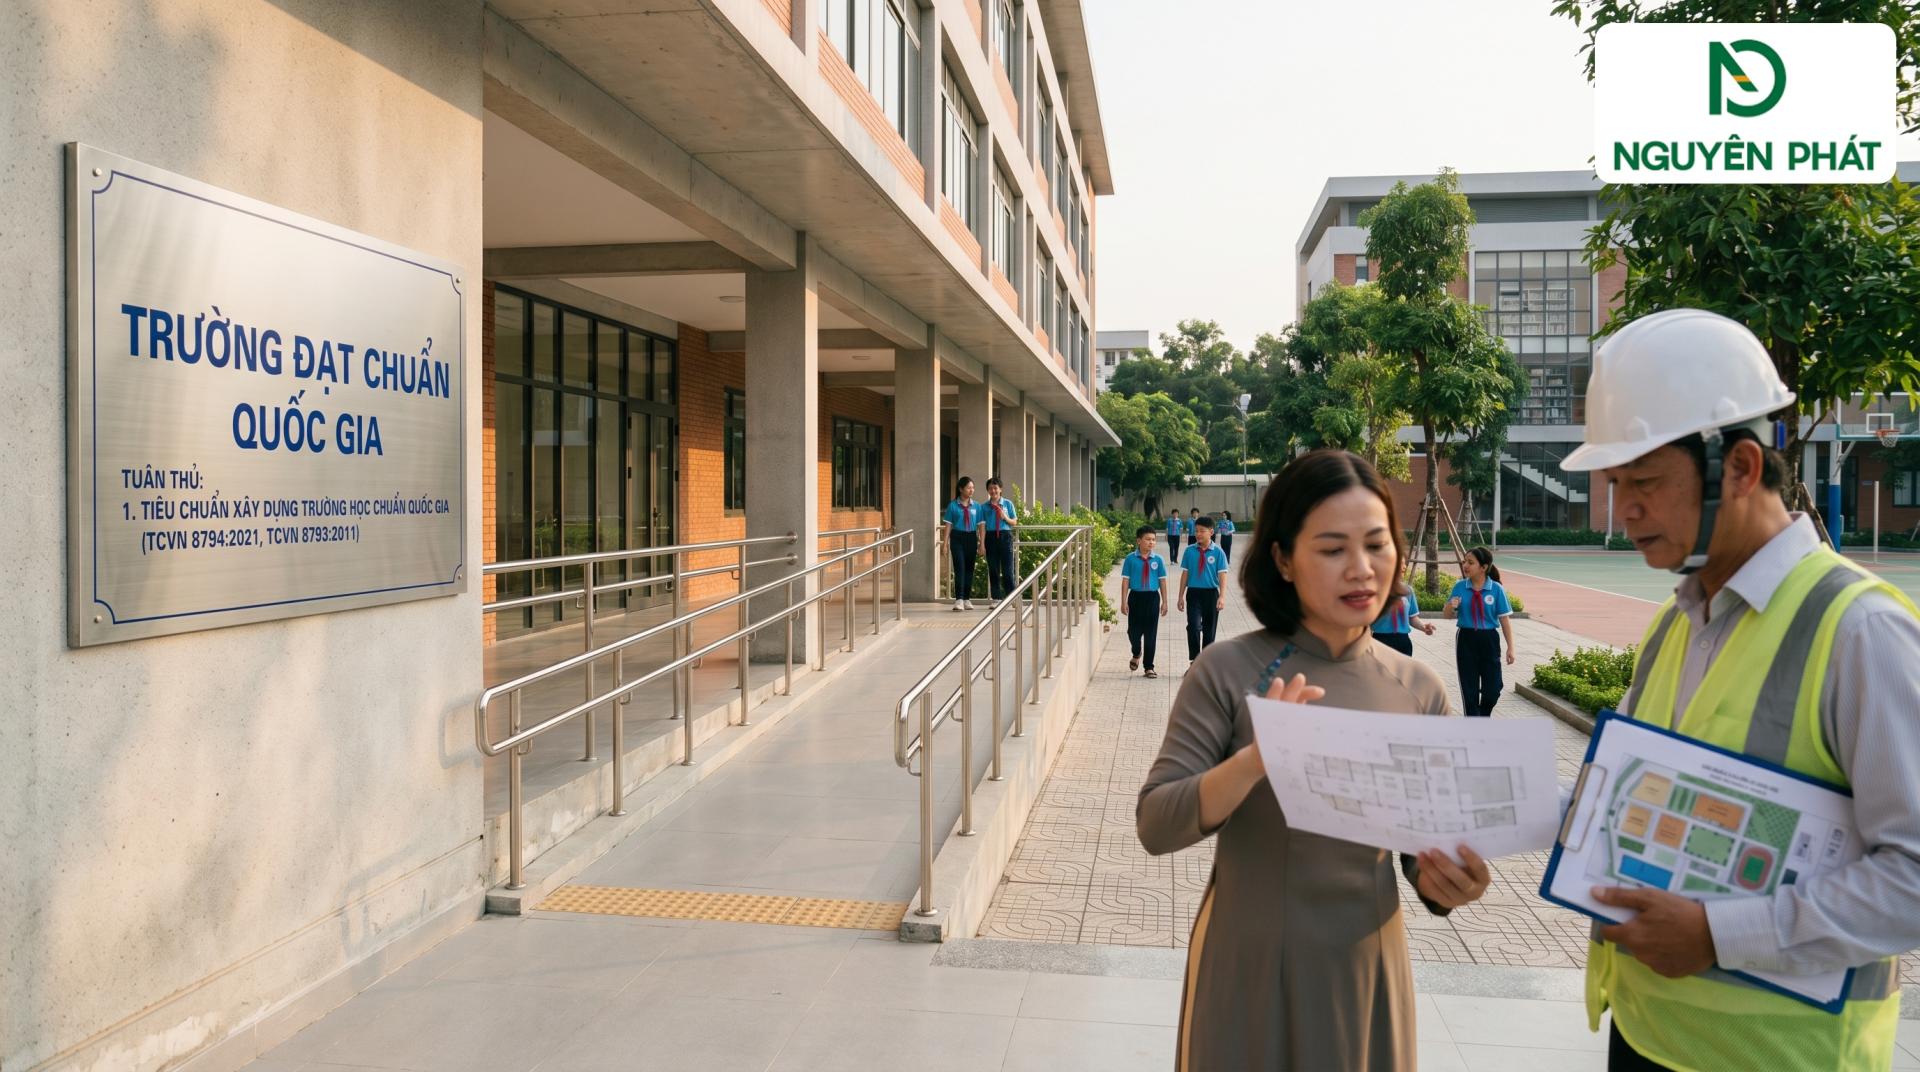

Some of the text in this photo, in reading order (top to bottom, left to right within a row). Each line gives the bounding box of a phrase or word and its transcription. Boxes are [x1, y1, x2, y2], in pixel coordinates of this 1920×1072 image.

[121, 303, 450, 398] TRƯỜNG ĐẠT CHUẨN
[232, 390, 384, 456] QUỐC GIA
[121, 463, 203, 489] TUÂN THỦ:
[123, 502, 136, 520] 1.
[141, 495, 175, 520] TIÊU
[180, 490, 229, 519] CHUẨN
[233, 496, 260, 518] XÂY
[264, 499, 298, 522] DỰNG
[302, 496, 347, 516] TRƯỜNG
[350, 500, 371, 520] HỌC
[408, 493, 433, 514] QUỐC
[435, 499, 450, 513] GIA
[142, 524, 360, 555] (TCVN 8794:2021, TCVN 8793:2011)
